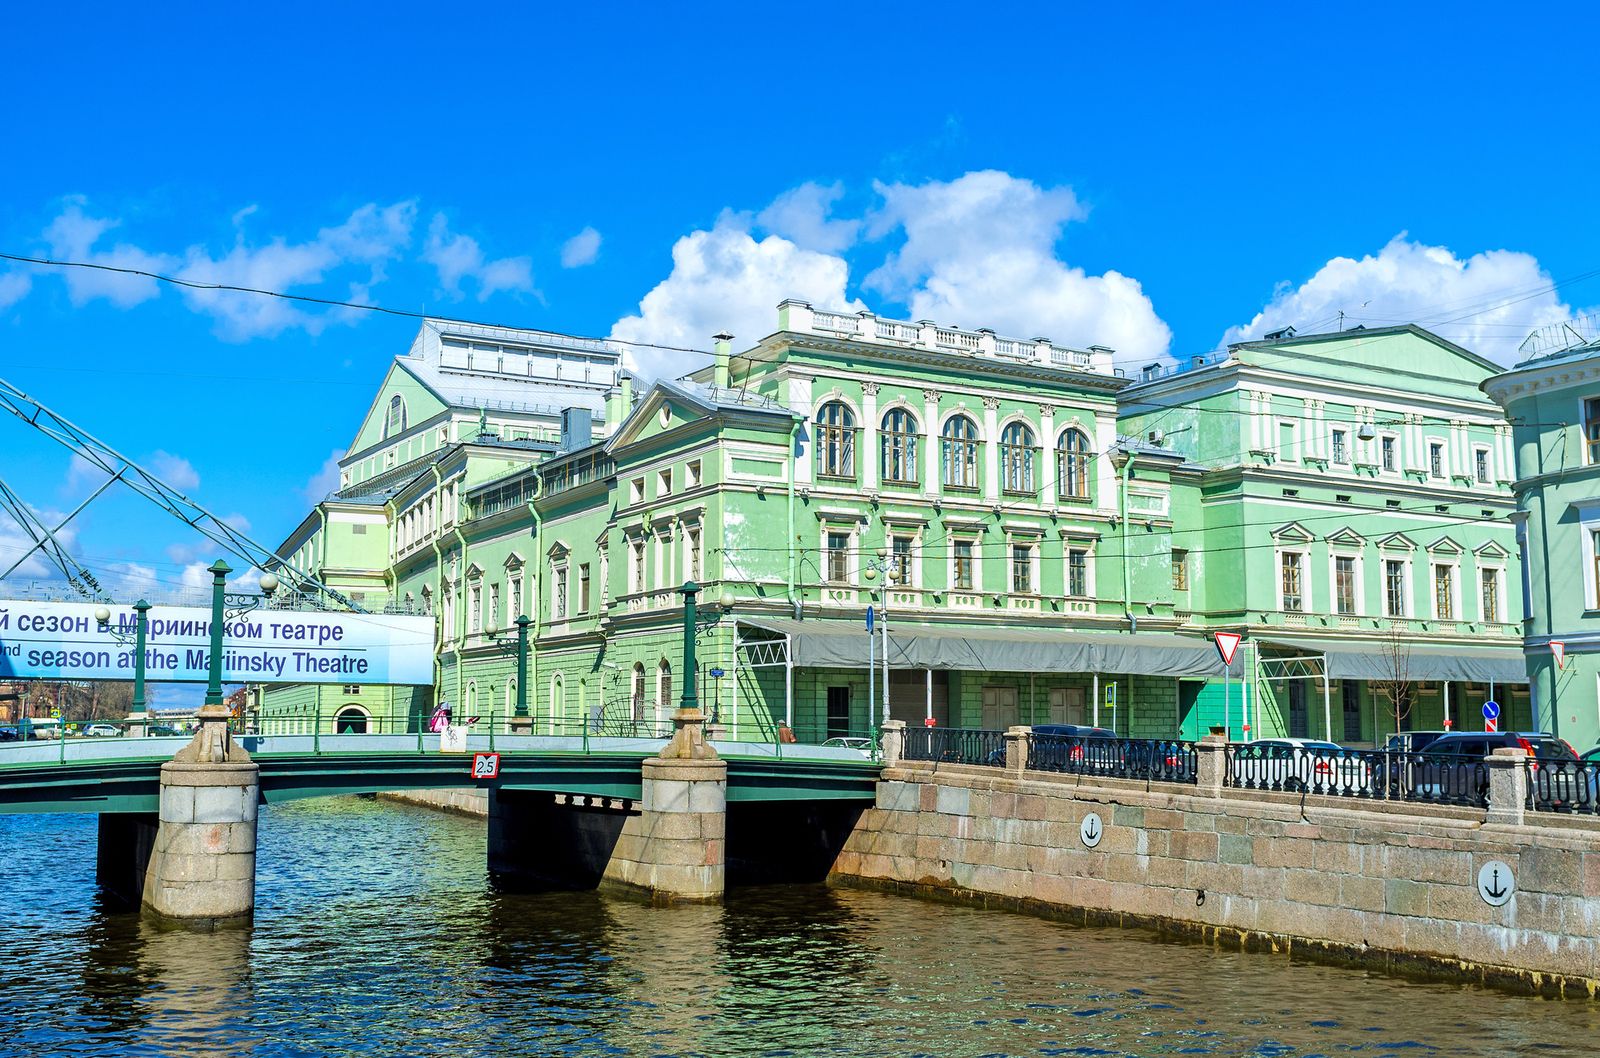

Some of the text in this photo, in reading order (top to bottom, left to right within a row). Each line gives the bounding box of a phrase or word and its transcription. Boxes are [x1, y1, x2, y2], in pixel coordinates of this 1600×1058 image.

[17, 614, 89, 633] сезон
[270, 622, 344, 646] театре
[27, 649, 110, 668] season
[145, 648, 178, 670] the
[292, 652, 368, 674] Theatre
[476, 761, 494, 773] 2.5
